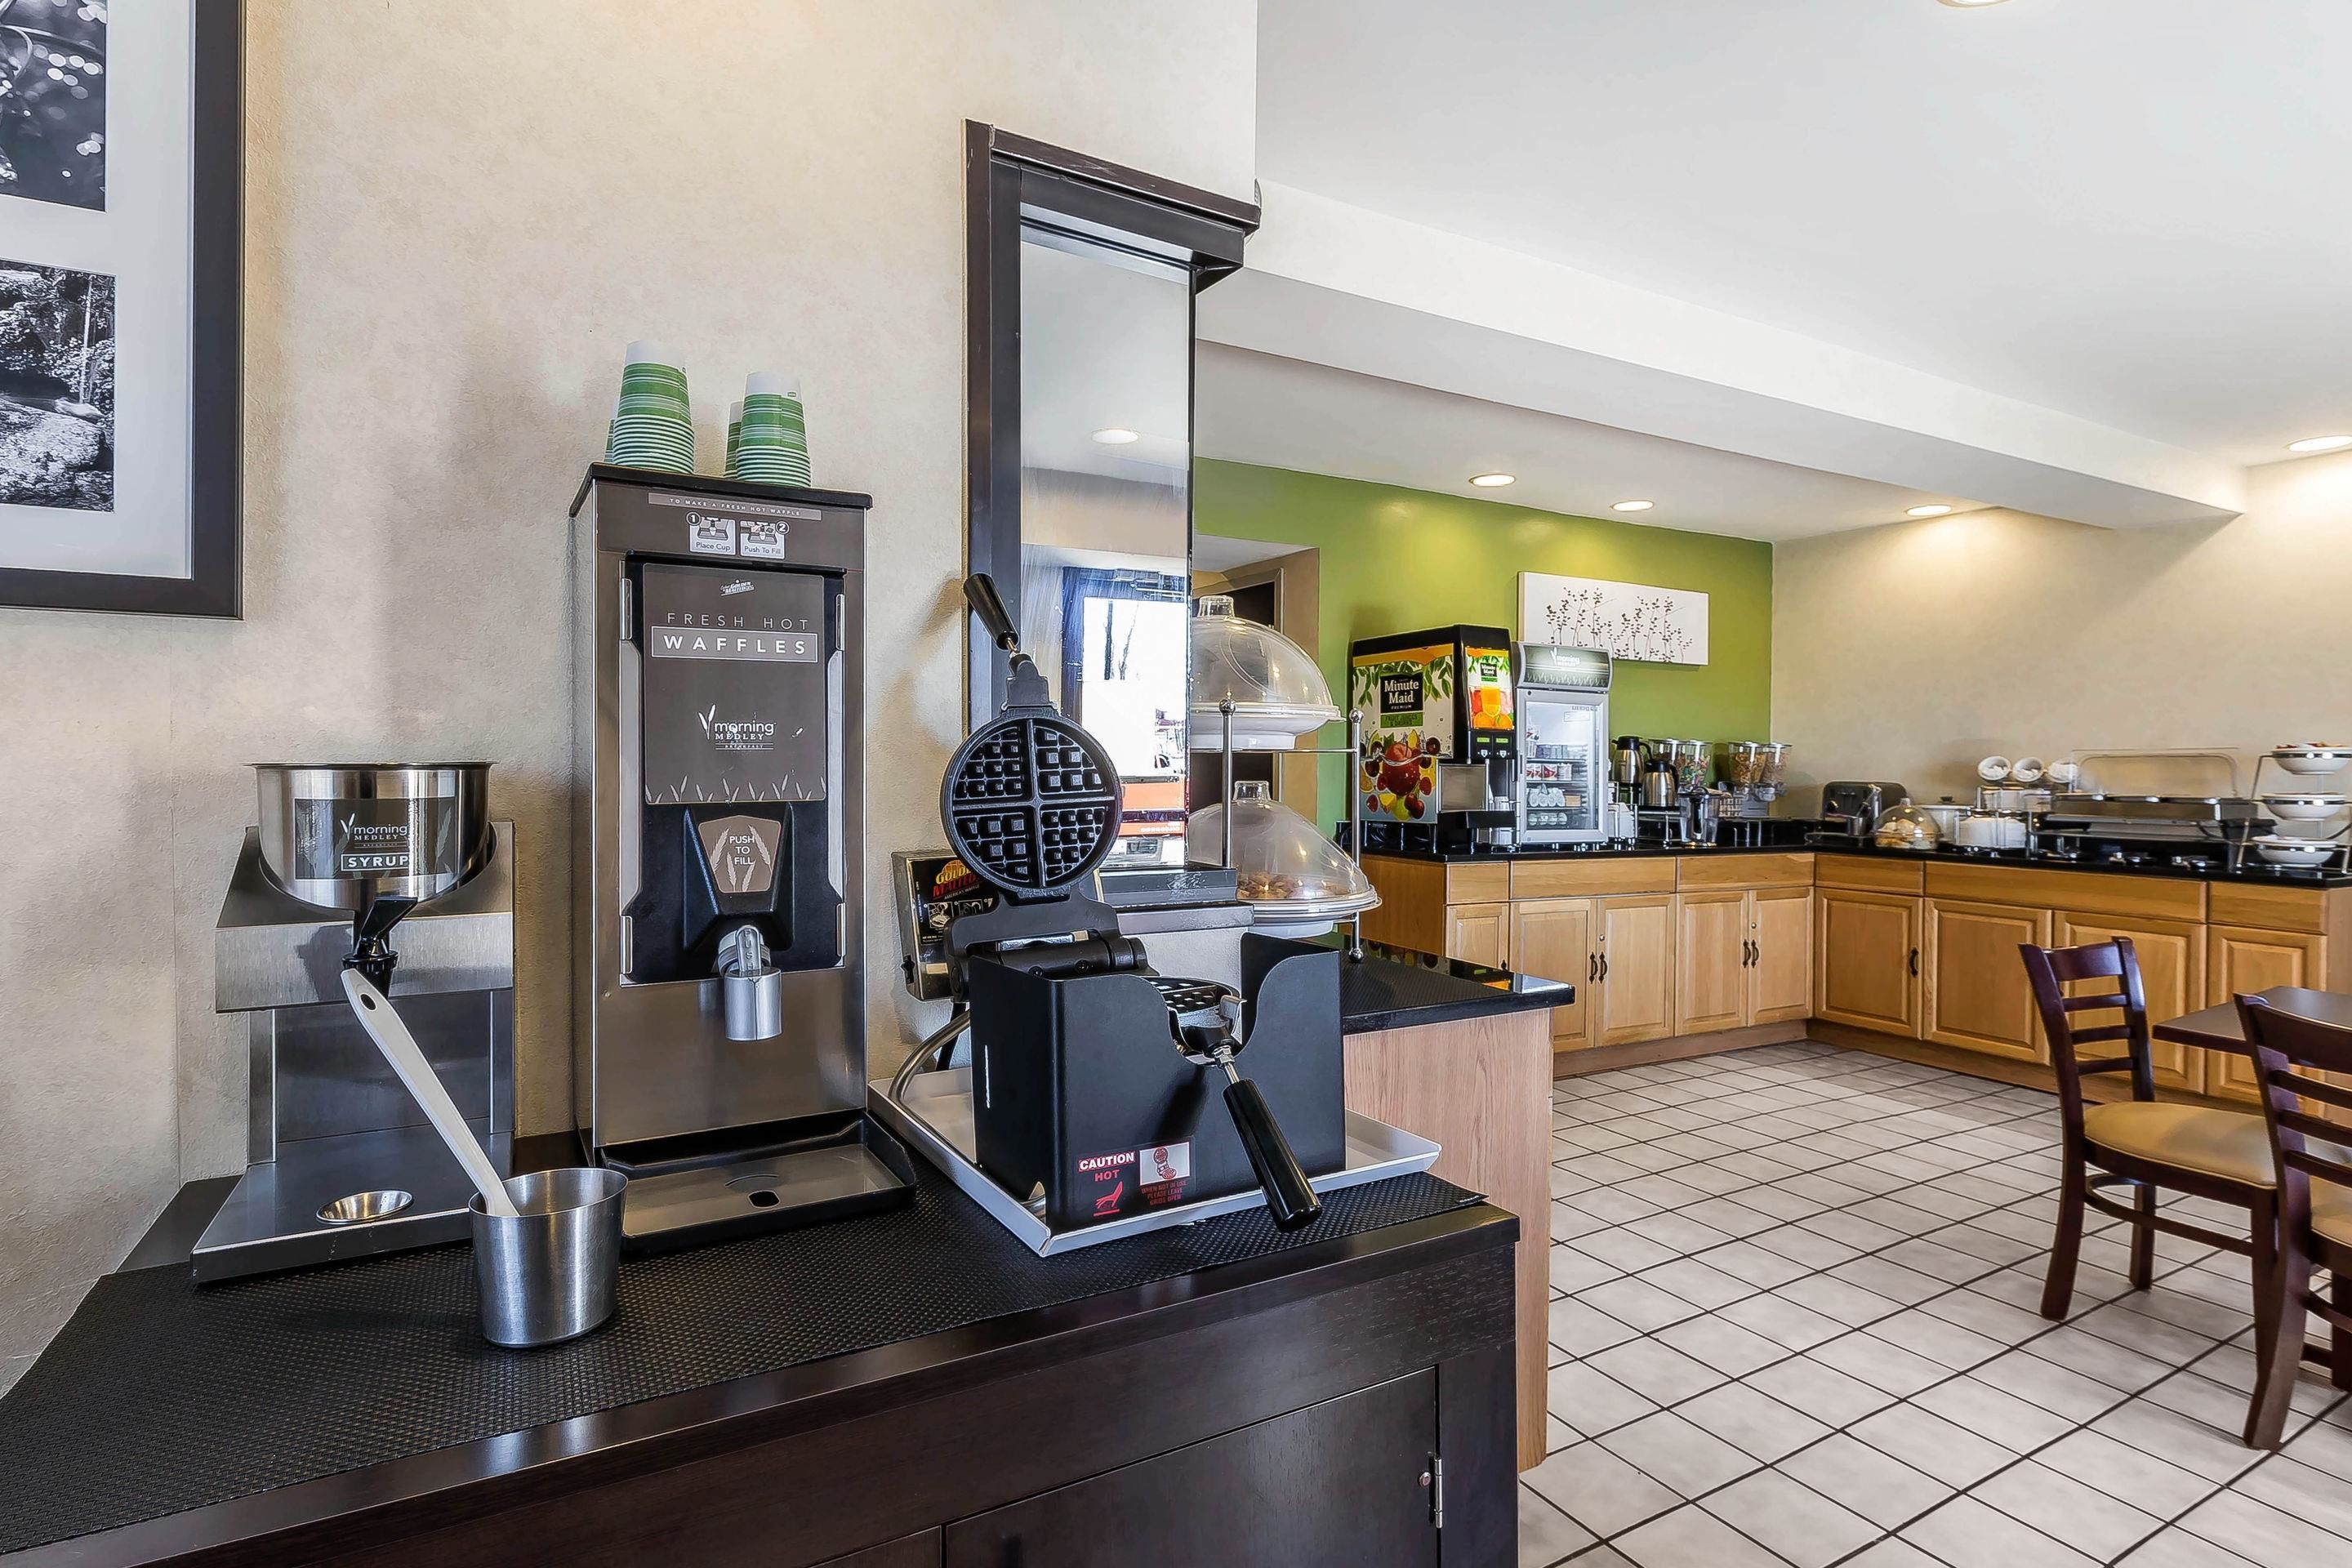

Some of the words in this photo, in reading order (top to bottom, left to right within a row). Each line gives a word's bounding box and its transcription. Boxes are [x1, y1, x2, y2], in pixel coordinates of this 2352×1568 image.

[770, 508, 800, 516] WAFFLE
[696, 541, 715, 550] Place
[715, 543, 731, 552] Cup
[744, 546, 760, 554] Push
[667, 612, 744, 627] FRESH
[764, 617, 808, 630] HOT
[663, 635, 805, 654] WAFFLES
[1384, 679, 1419, 693] Minute
[1388, 690, 1414, 704] Maid
[715, 720, 774, 736] morning
[354, 823, 408, 836] morning
[729, 835, 755, 844] PUSH
[735, 846, 751, 854] TO
[348, 855, 408, 867] SYRUP
[734, 857, 754, 865] FILL
[743, 929, 754, 969] PUSH
[1079, 1152, 1134, 1170] CAUTION
[1094, 1169, 1120, 1182] HOT
[1147, 1191, 1167, 1200] PLEASE
